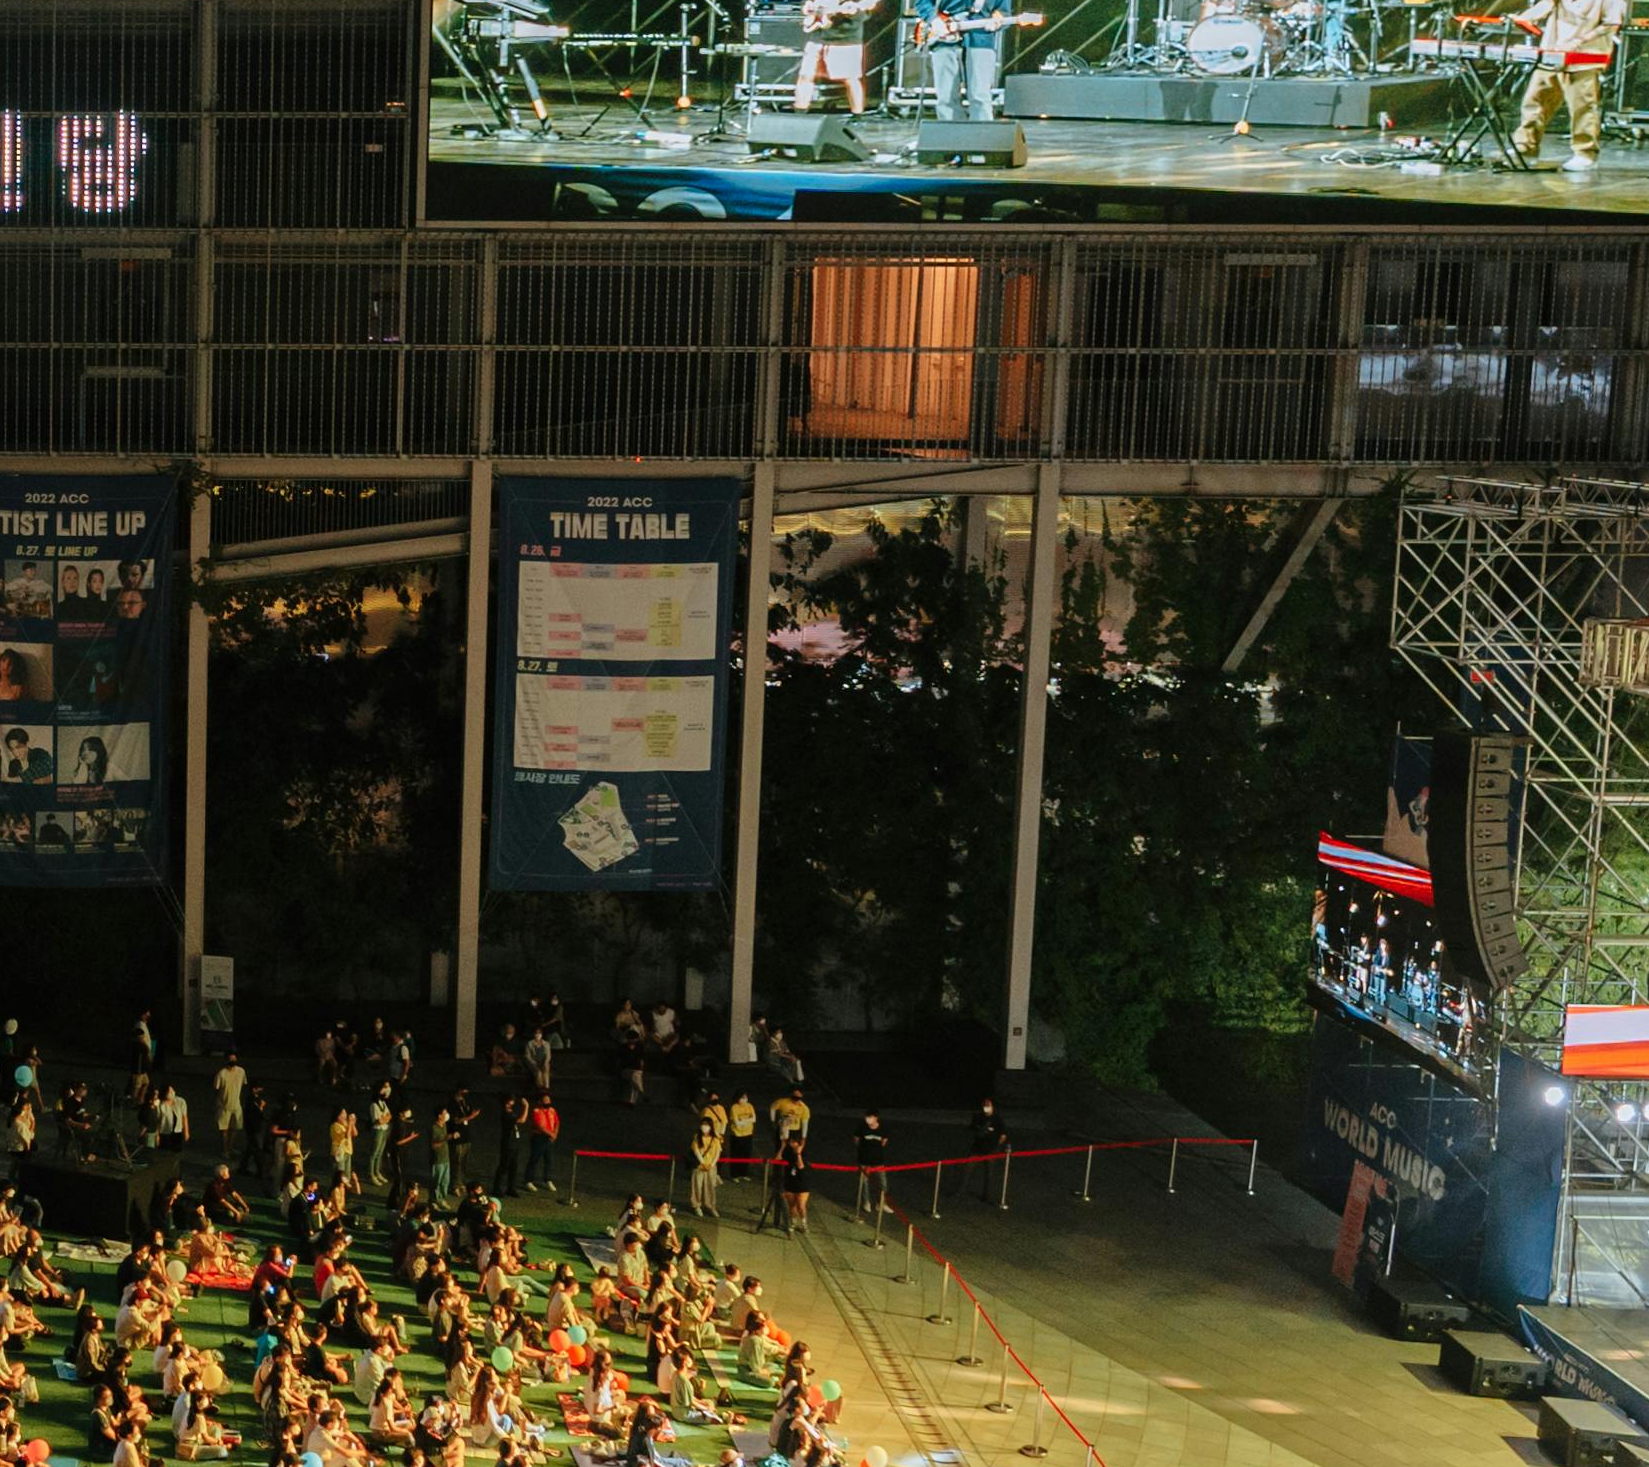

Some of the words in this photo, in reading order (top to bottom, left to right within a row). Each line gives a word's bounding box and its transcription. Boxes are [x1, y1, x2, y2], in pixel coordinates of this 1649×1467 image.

[24, 493, 56, 504] 2022
[59, 493, 90, 504] ACC
[587, 497, 619, 508] 2022
[622, 497, 653, 508] ACC
[56, 510, 109, 537] LINE
[115, 510, 147, 536] UP
[550, 512, 609, 540] TIME
[615, 513, 691, 540] TABLE
[57, 546, 82, 557] LINE
[83, 546, 99, 557] UP
[1324, 1097, 1379, 1160] WORLD
[1383, 1136, 1446, 1201] MUSIC
